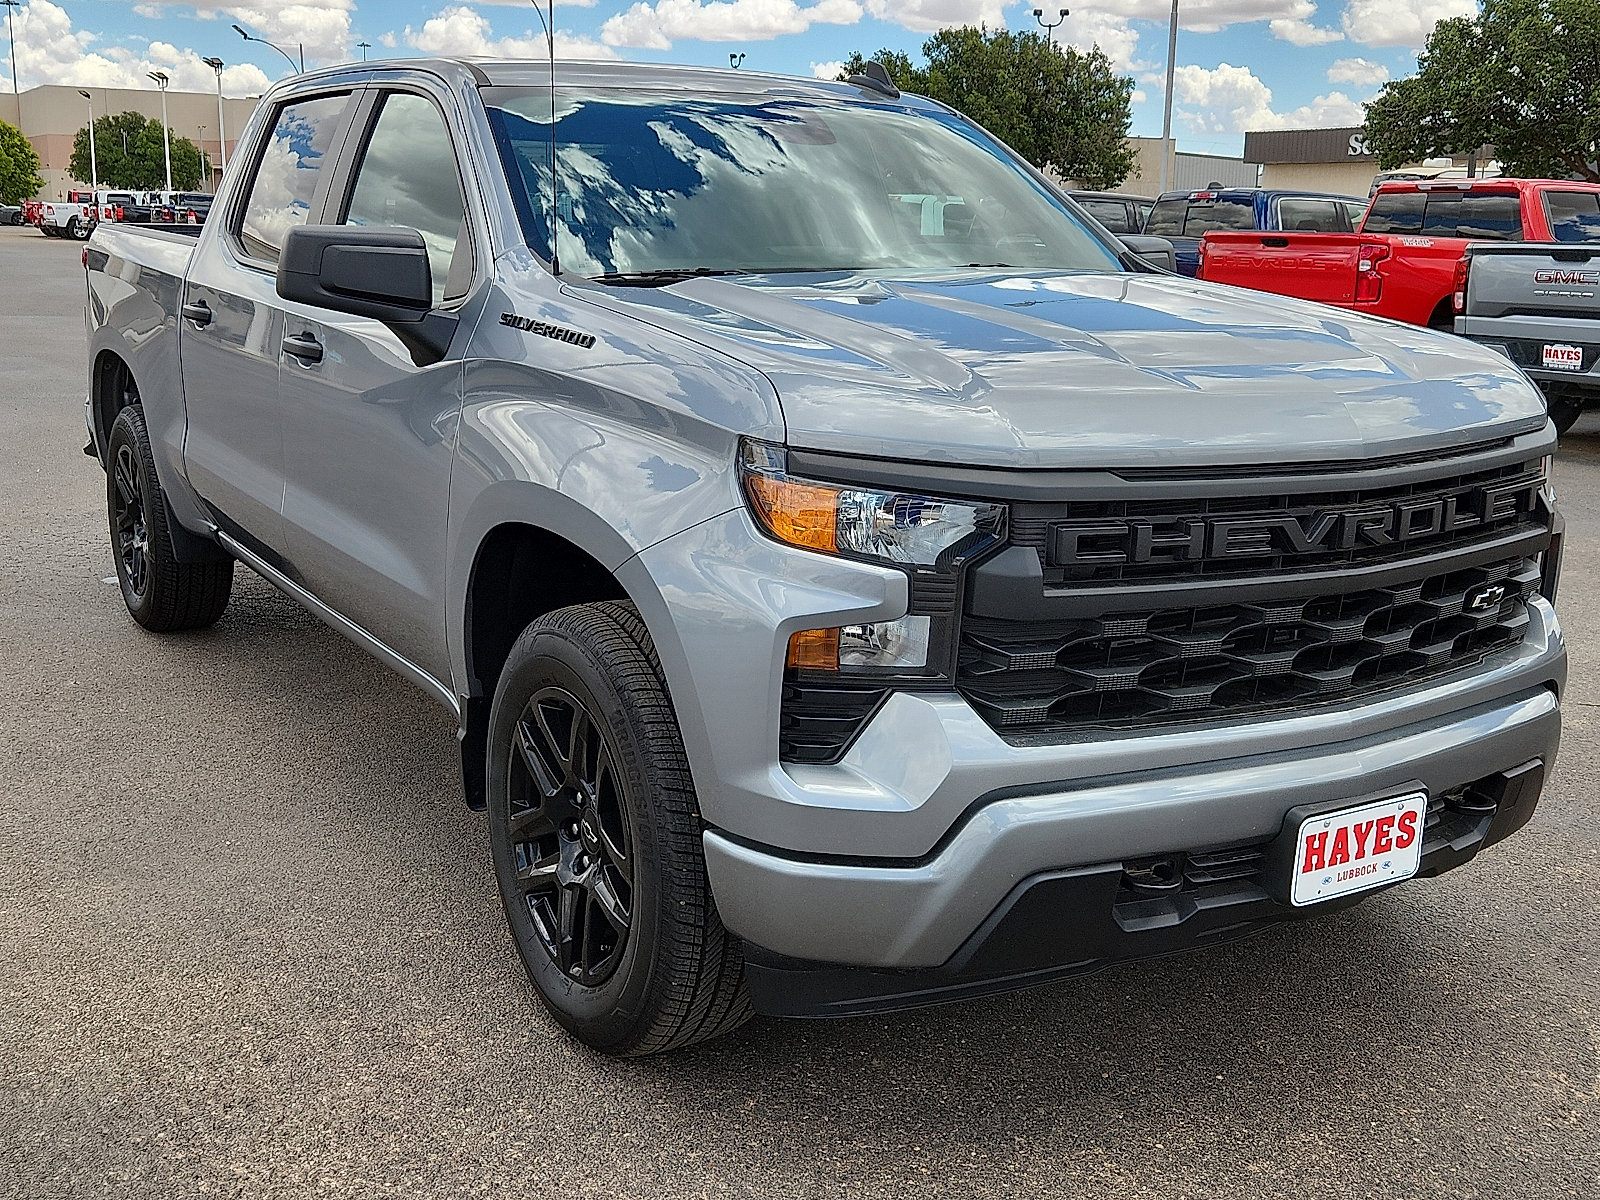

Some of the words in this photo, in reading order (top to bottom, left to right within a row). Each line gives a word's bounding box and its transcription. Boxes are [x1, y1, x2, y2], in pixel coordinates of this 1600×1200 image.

[1534, 269, 1599, 285] GMC
[499, 312, 597, 349] SILVERADO
[1545, 349, 1581, 361] HAYES
[1050, 477, 1547, 566] CHEVROLET
[1302, 810, 1418, 874] HAYES
[1336, 863, 1378, 882] LUBBOCK
